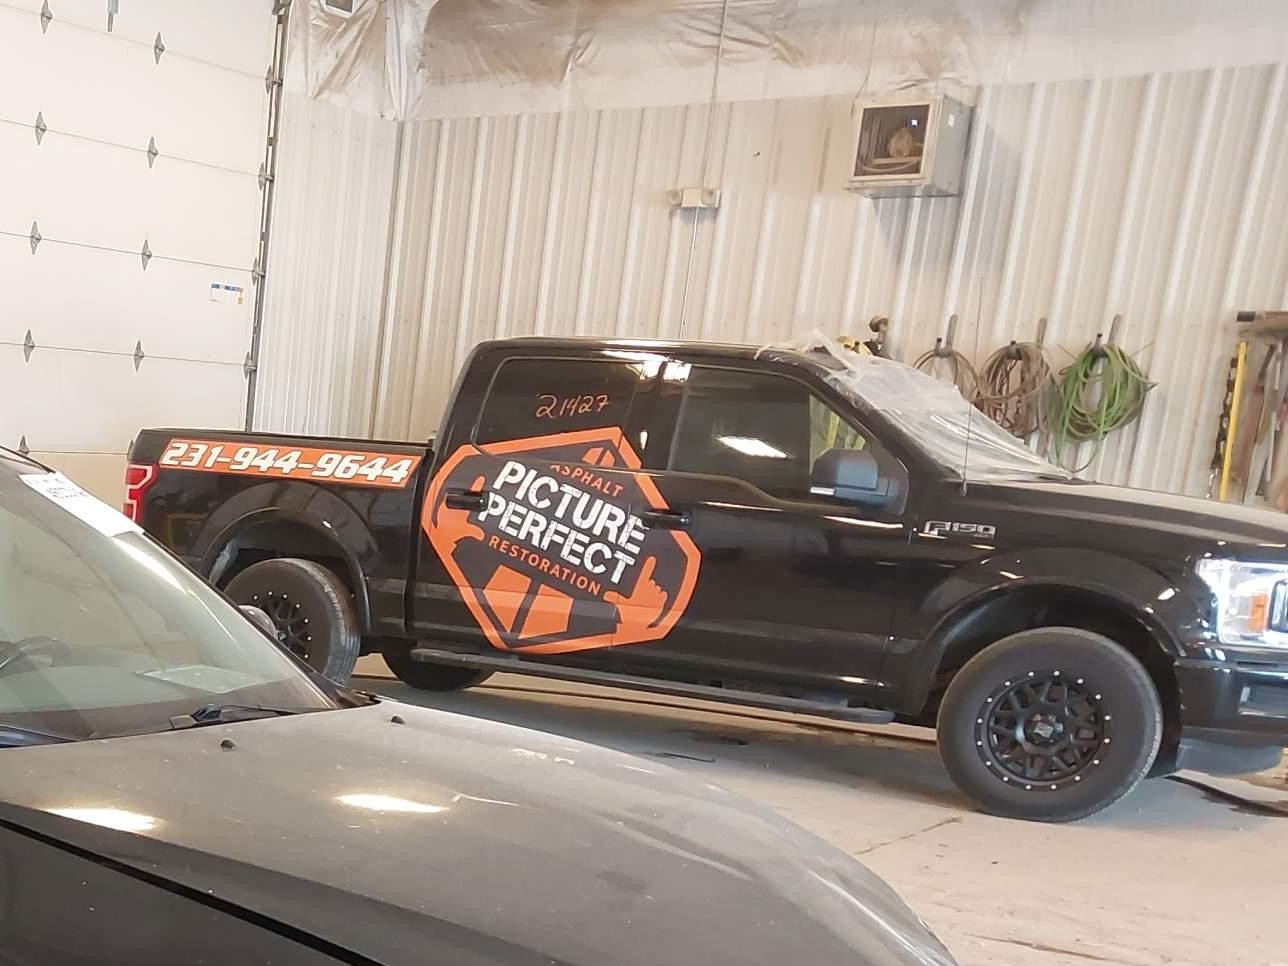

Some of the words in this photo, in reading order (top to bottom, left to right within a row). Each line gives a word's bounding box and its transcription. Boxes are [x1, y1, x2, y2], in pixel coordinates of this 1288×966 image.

[536, 394, 610, 419] 21427
[161, 442, 413, 484] 231-944-9644
[478, 492, 636, 585] PERFECT
[493, 461, 647, 555] PICTURE
[489, 535, 601, 596] RESTORATION
